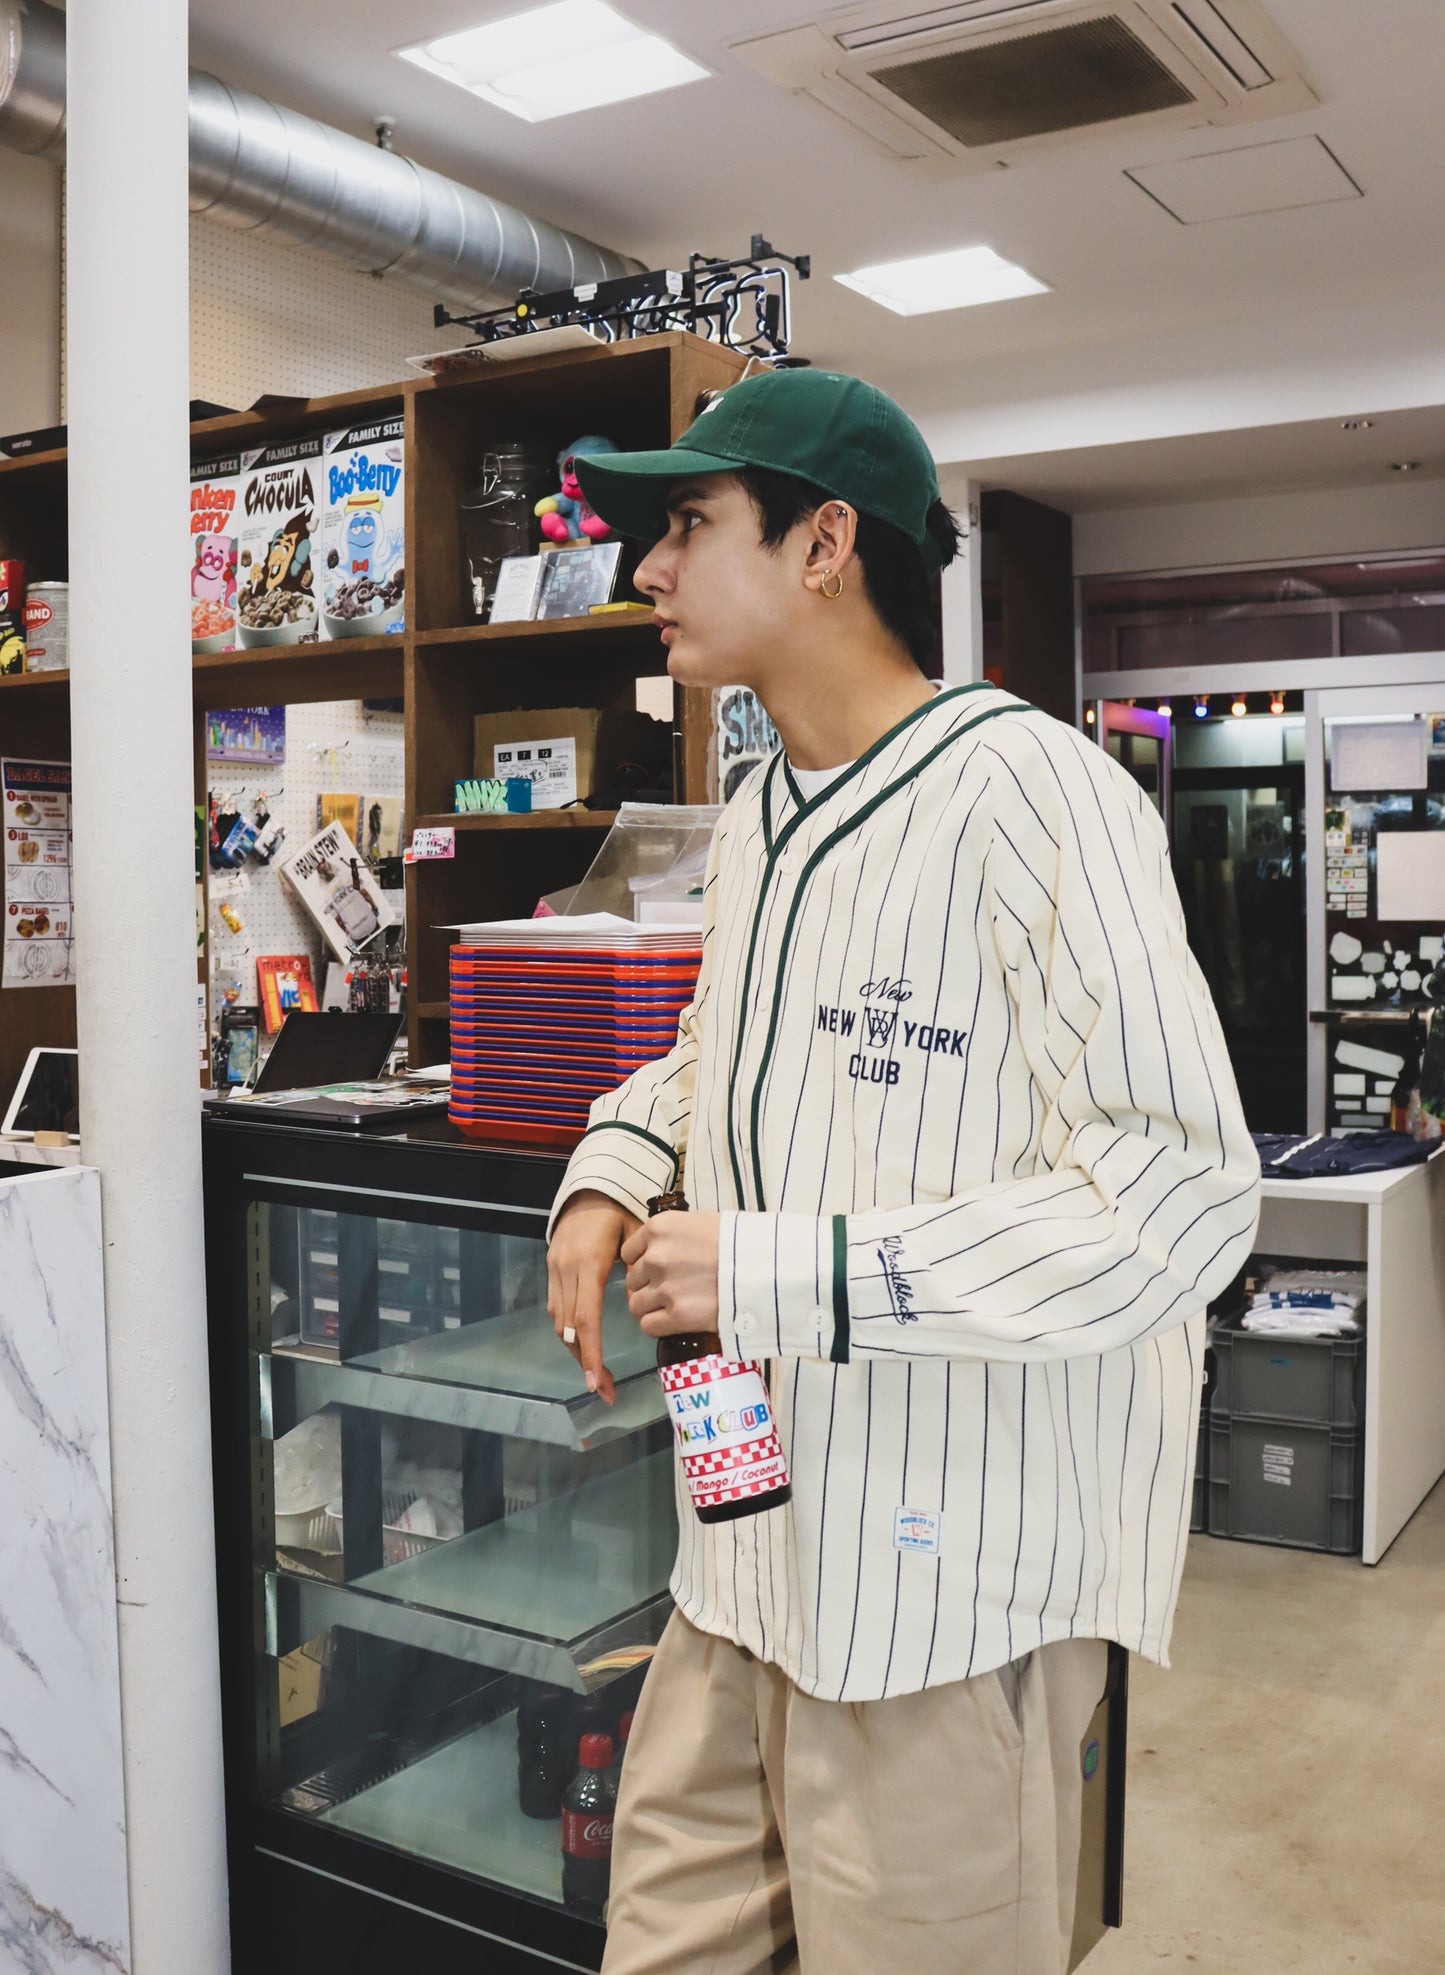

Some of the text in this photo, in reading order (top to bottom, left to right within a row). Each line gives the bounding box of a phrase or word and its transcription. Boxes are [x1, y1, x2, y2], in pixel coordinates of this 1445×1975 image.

[348, 426, 381, 444] FAMILY
[382, 421, 404, 436] SIZE
[266, 445, 298, 461] FAMILY
[299, 440, 319, 455] SIZE
[219, 459, 238, 473] SIZE
[265, 469, 294, 483] COUNT
[245, 466, 315, 517] CHOCULA
[859, 977, 912, 1002] New
[818, 1004, 967, 1057] NEW YORK
[849, 1054, 901, 1085] CLUB
[696, 1477, 729, 1491] Mango
[742, 1461, 779, 1481] Coconut
